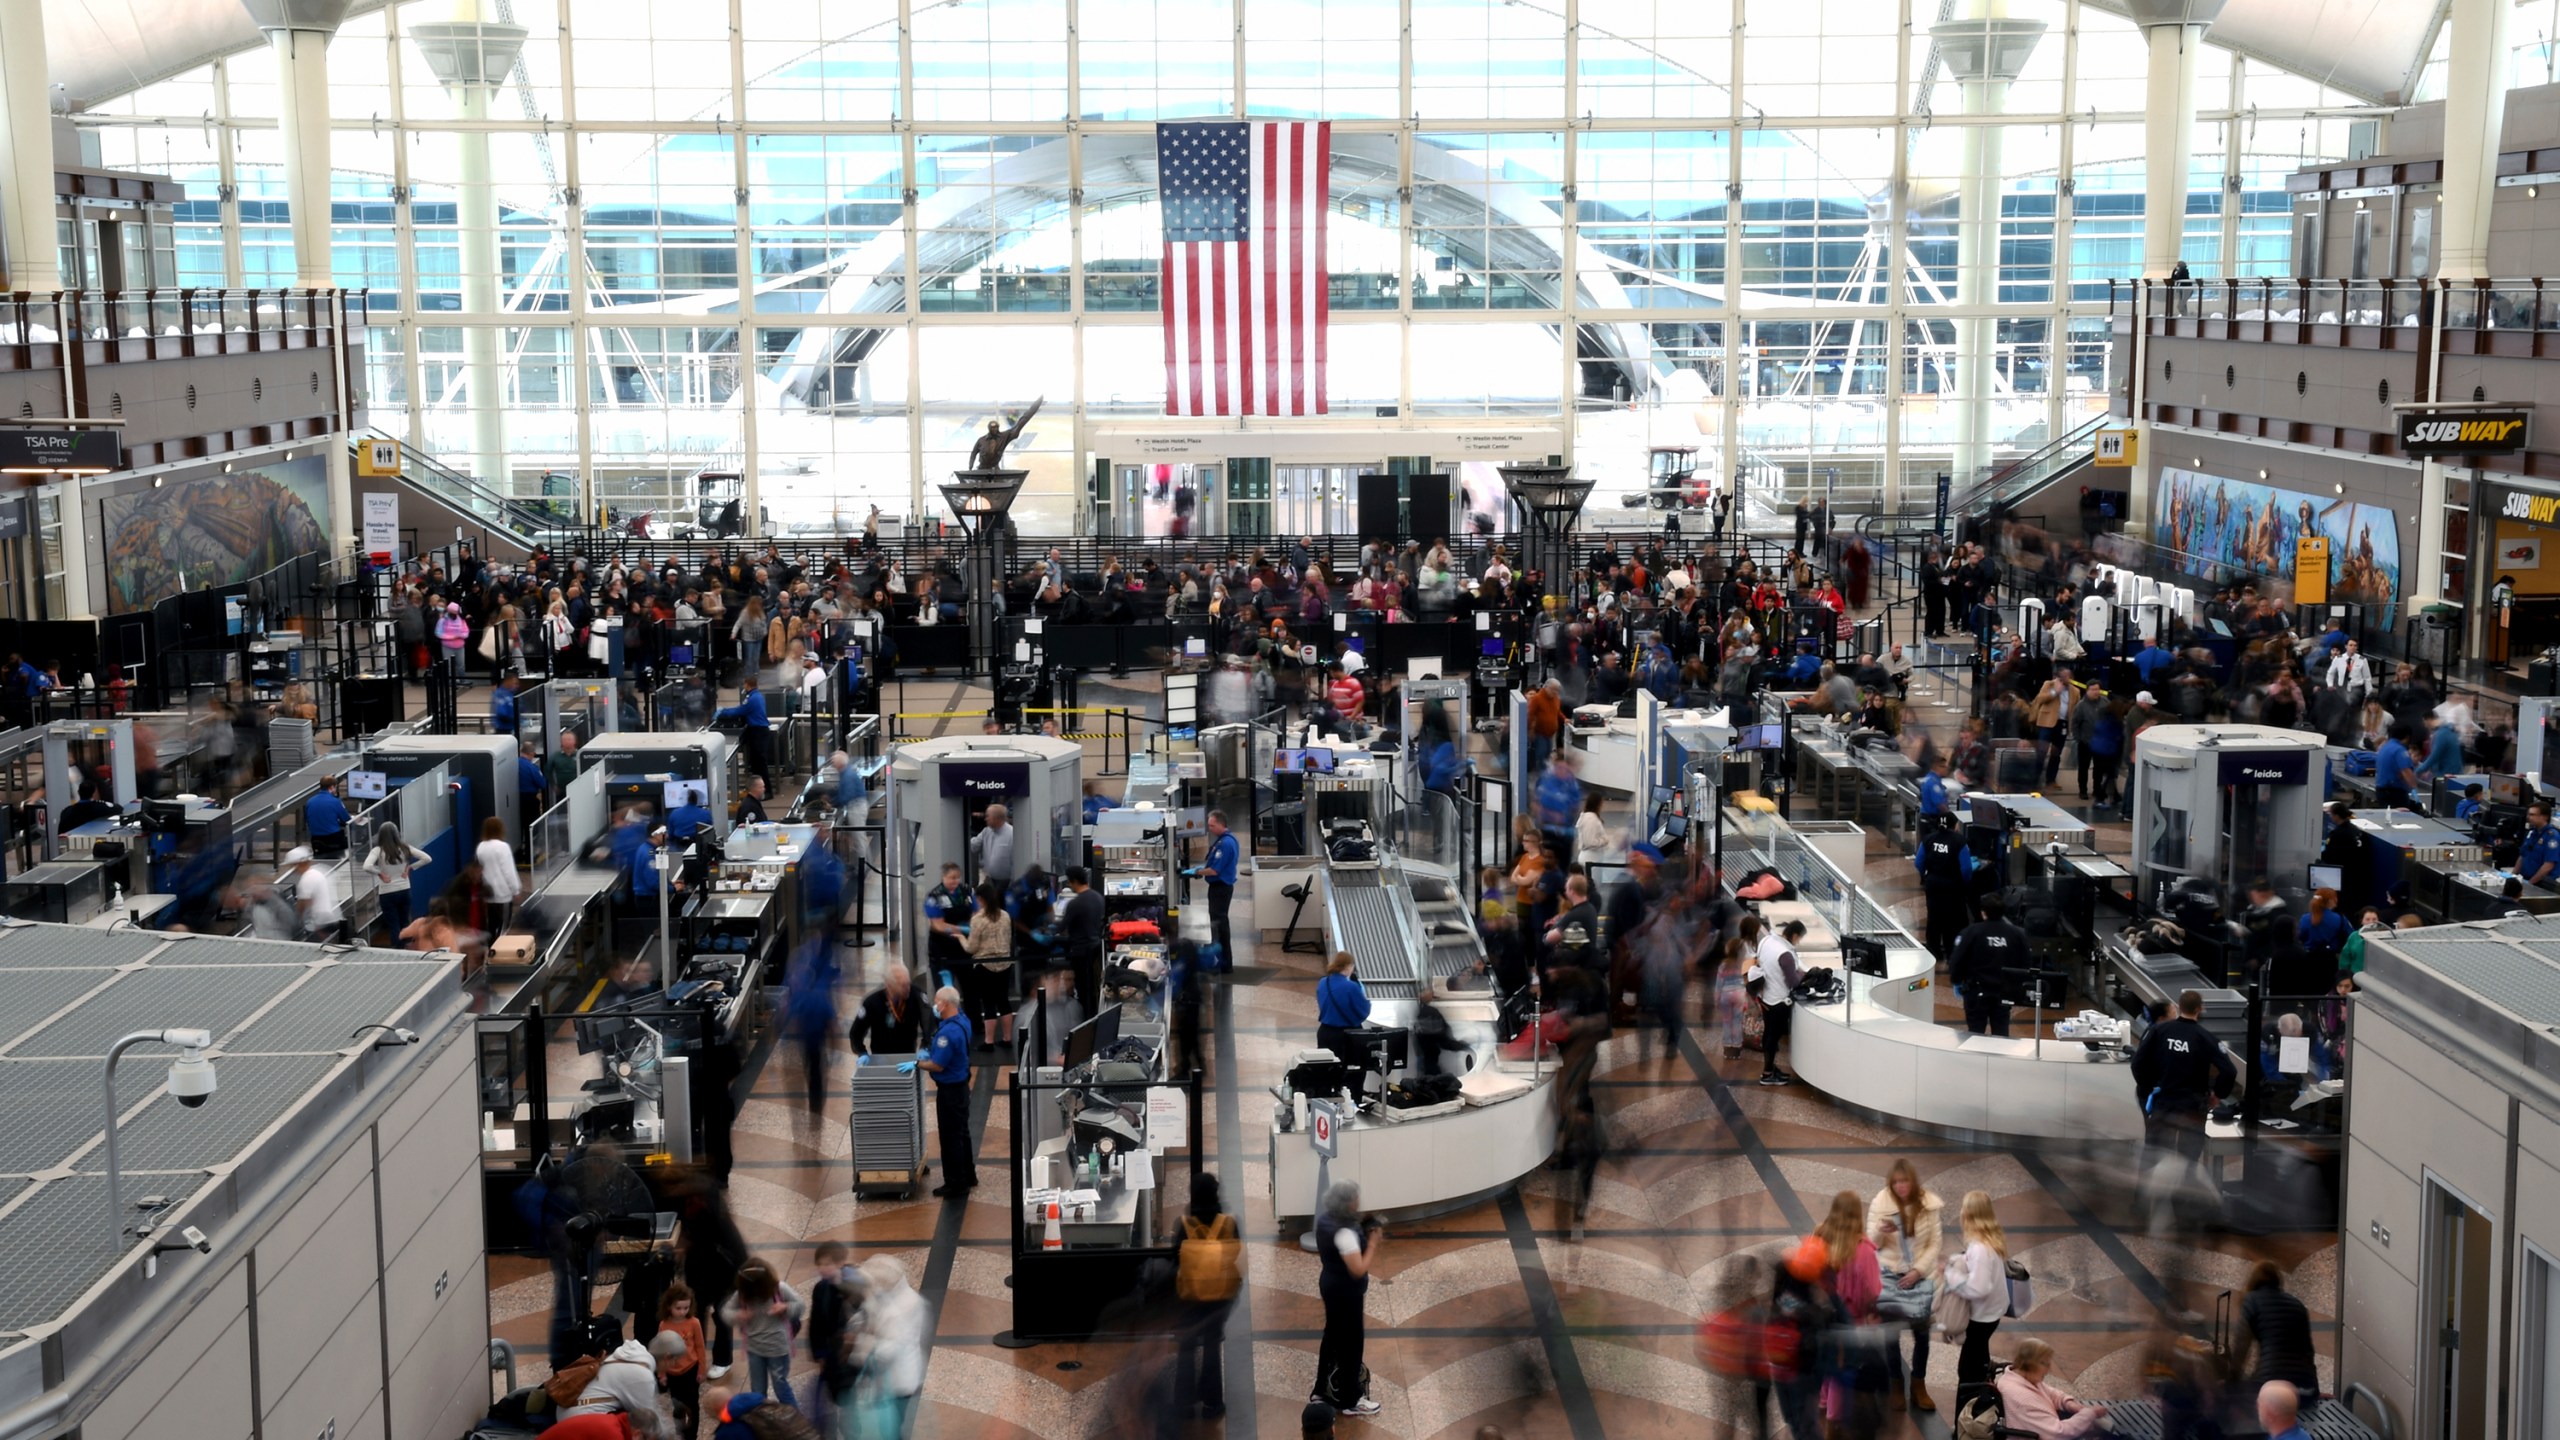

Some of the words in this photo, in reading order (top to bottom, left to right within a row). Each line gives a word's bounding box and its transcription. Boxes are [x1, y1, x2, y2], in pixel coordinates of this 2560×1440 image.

[2406, 419, 2523, 443] SUBWAY
[24, 436, 47, 447] TSA
[49, 436, 69, 447] Pre
[2502, 491, 2560, 523] SUBWAY
[1444, 686, 1457, 697] 10
[2254, 769, 2282, 778] leidos
[976, 780, 1006, 790] leidos
[1933, 842, 1948, 854] TSA
[1986, 936, 2008, 947] TSA
[2167, 1038, 2190, 1053] TSA
